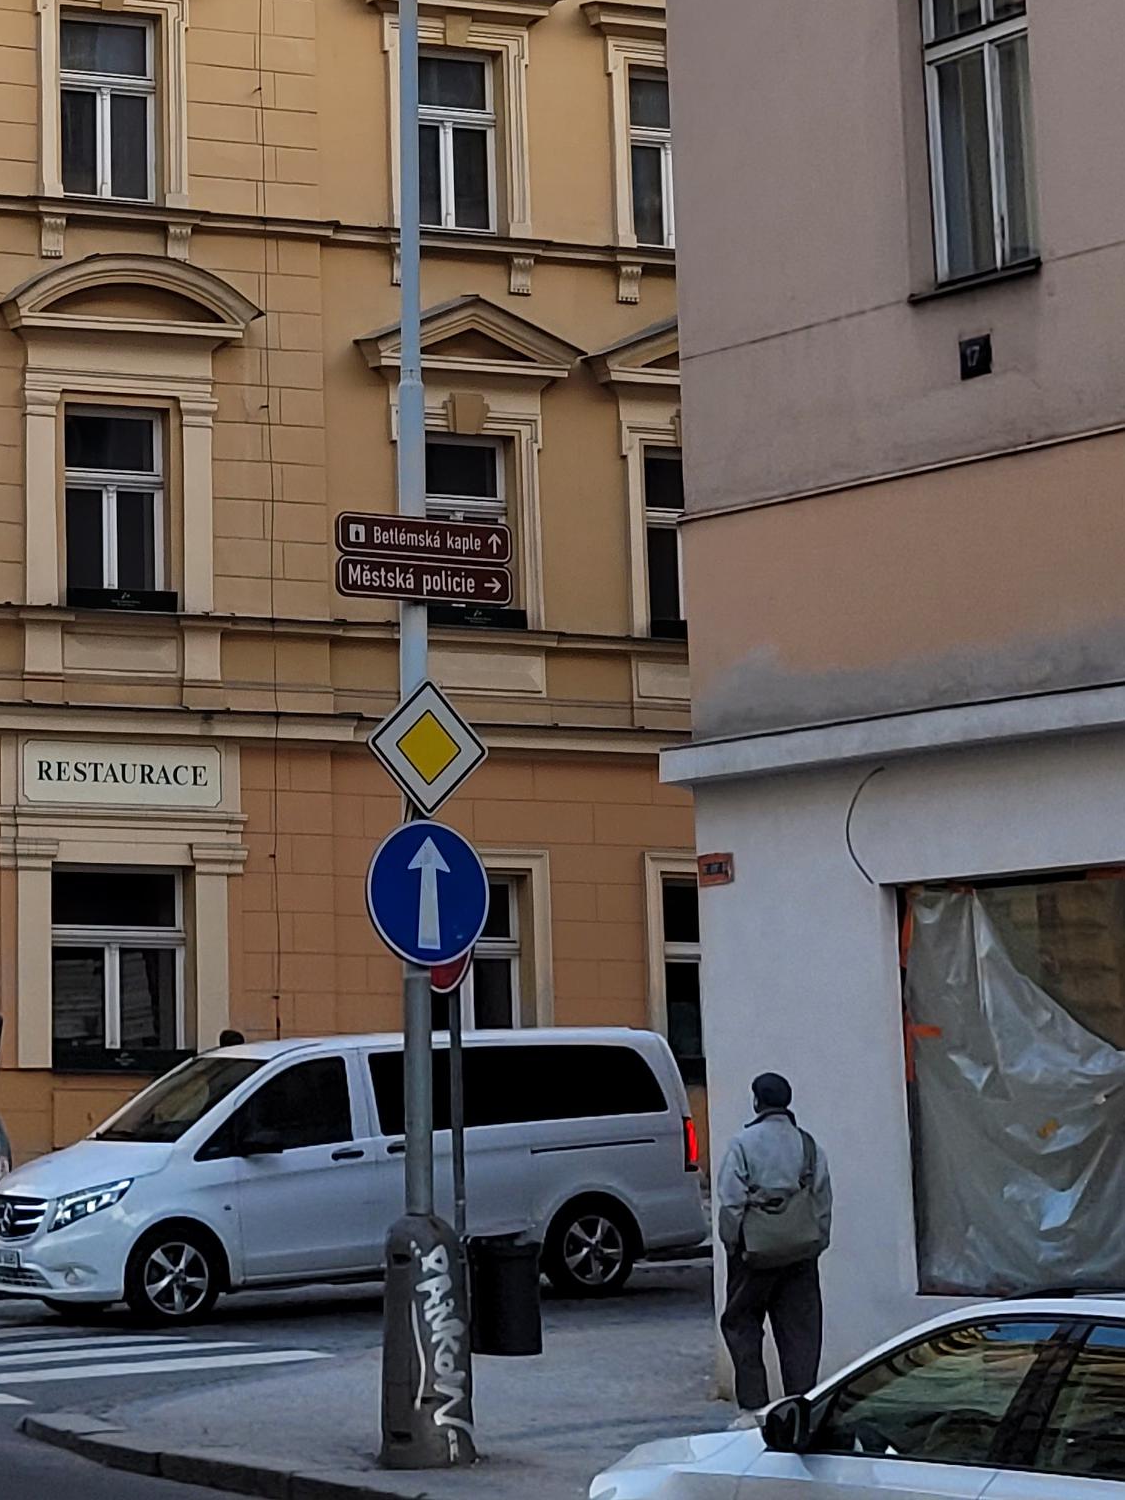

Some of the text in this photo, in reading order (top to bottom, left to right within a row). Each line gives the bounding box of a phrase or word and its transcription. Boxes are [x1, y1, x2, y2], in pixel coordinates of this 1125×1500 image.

[373, 525, 481, 555] Betlémská kaple
[348, 563, 475, 596] Městská policie
[37, 759, 209, 787] RESTAURACE
